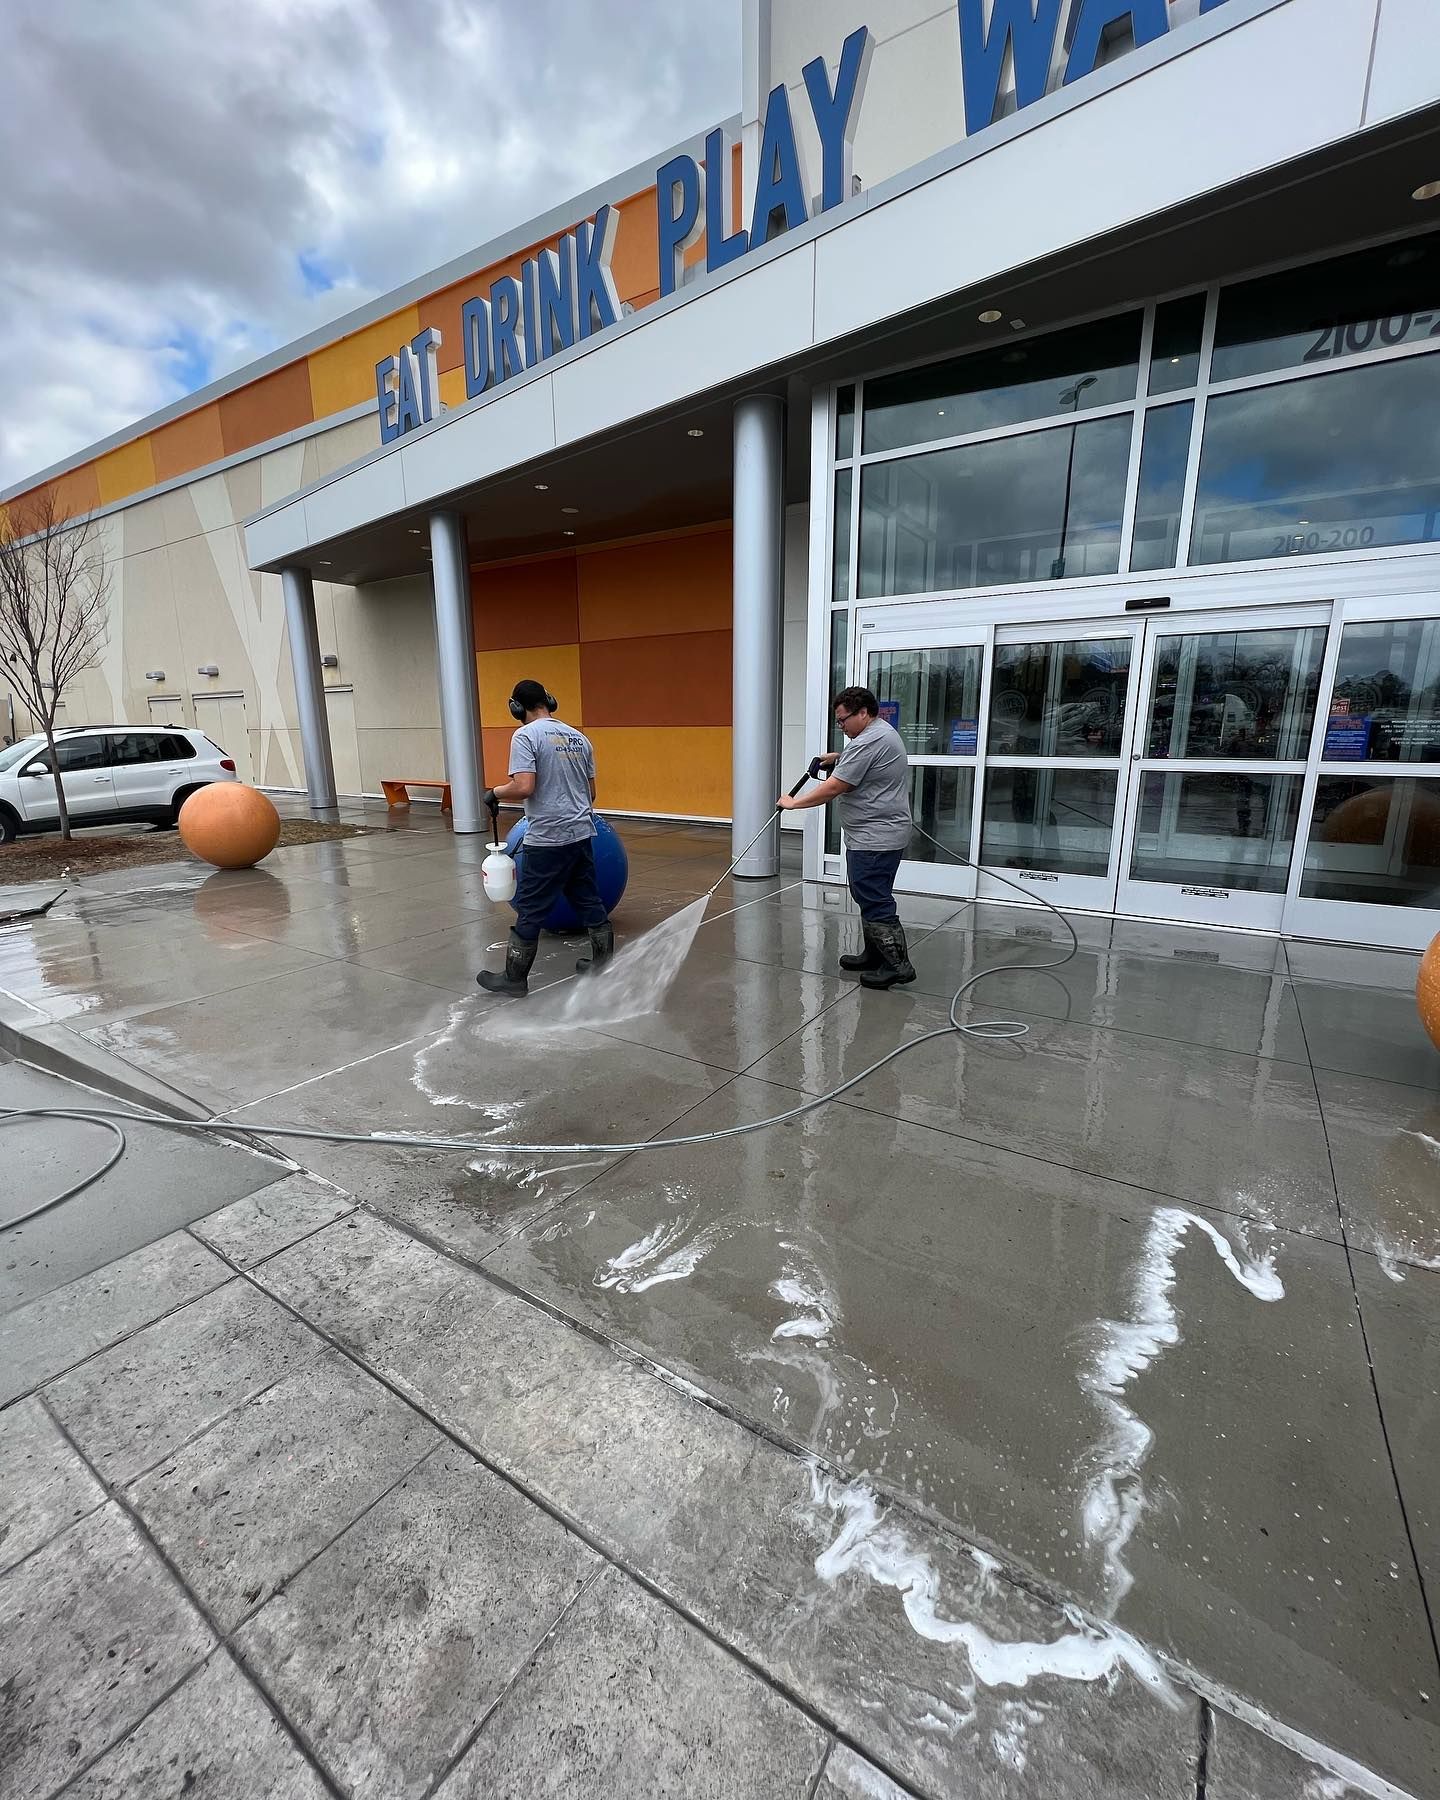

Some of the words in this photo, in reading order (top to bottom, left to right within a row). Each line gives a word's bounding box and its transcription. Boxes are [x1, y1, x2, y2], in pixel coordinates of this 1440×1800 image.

[375, 327, 441, 445] EAT
[461, 203, 620, 400] DRINK
[656, 25, 872, 299] PLAY
